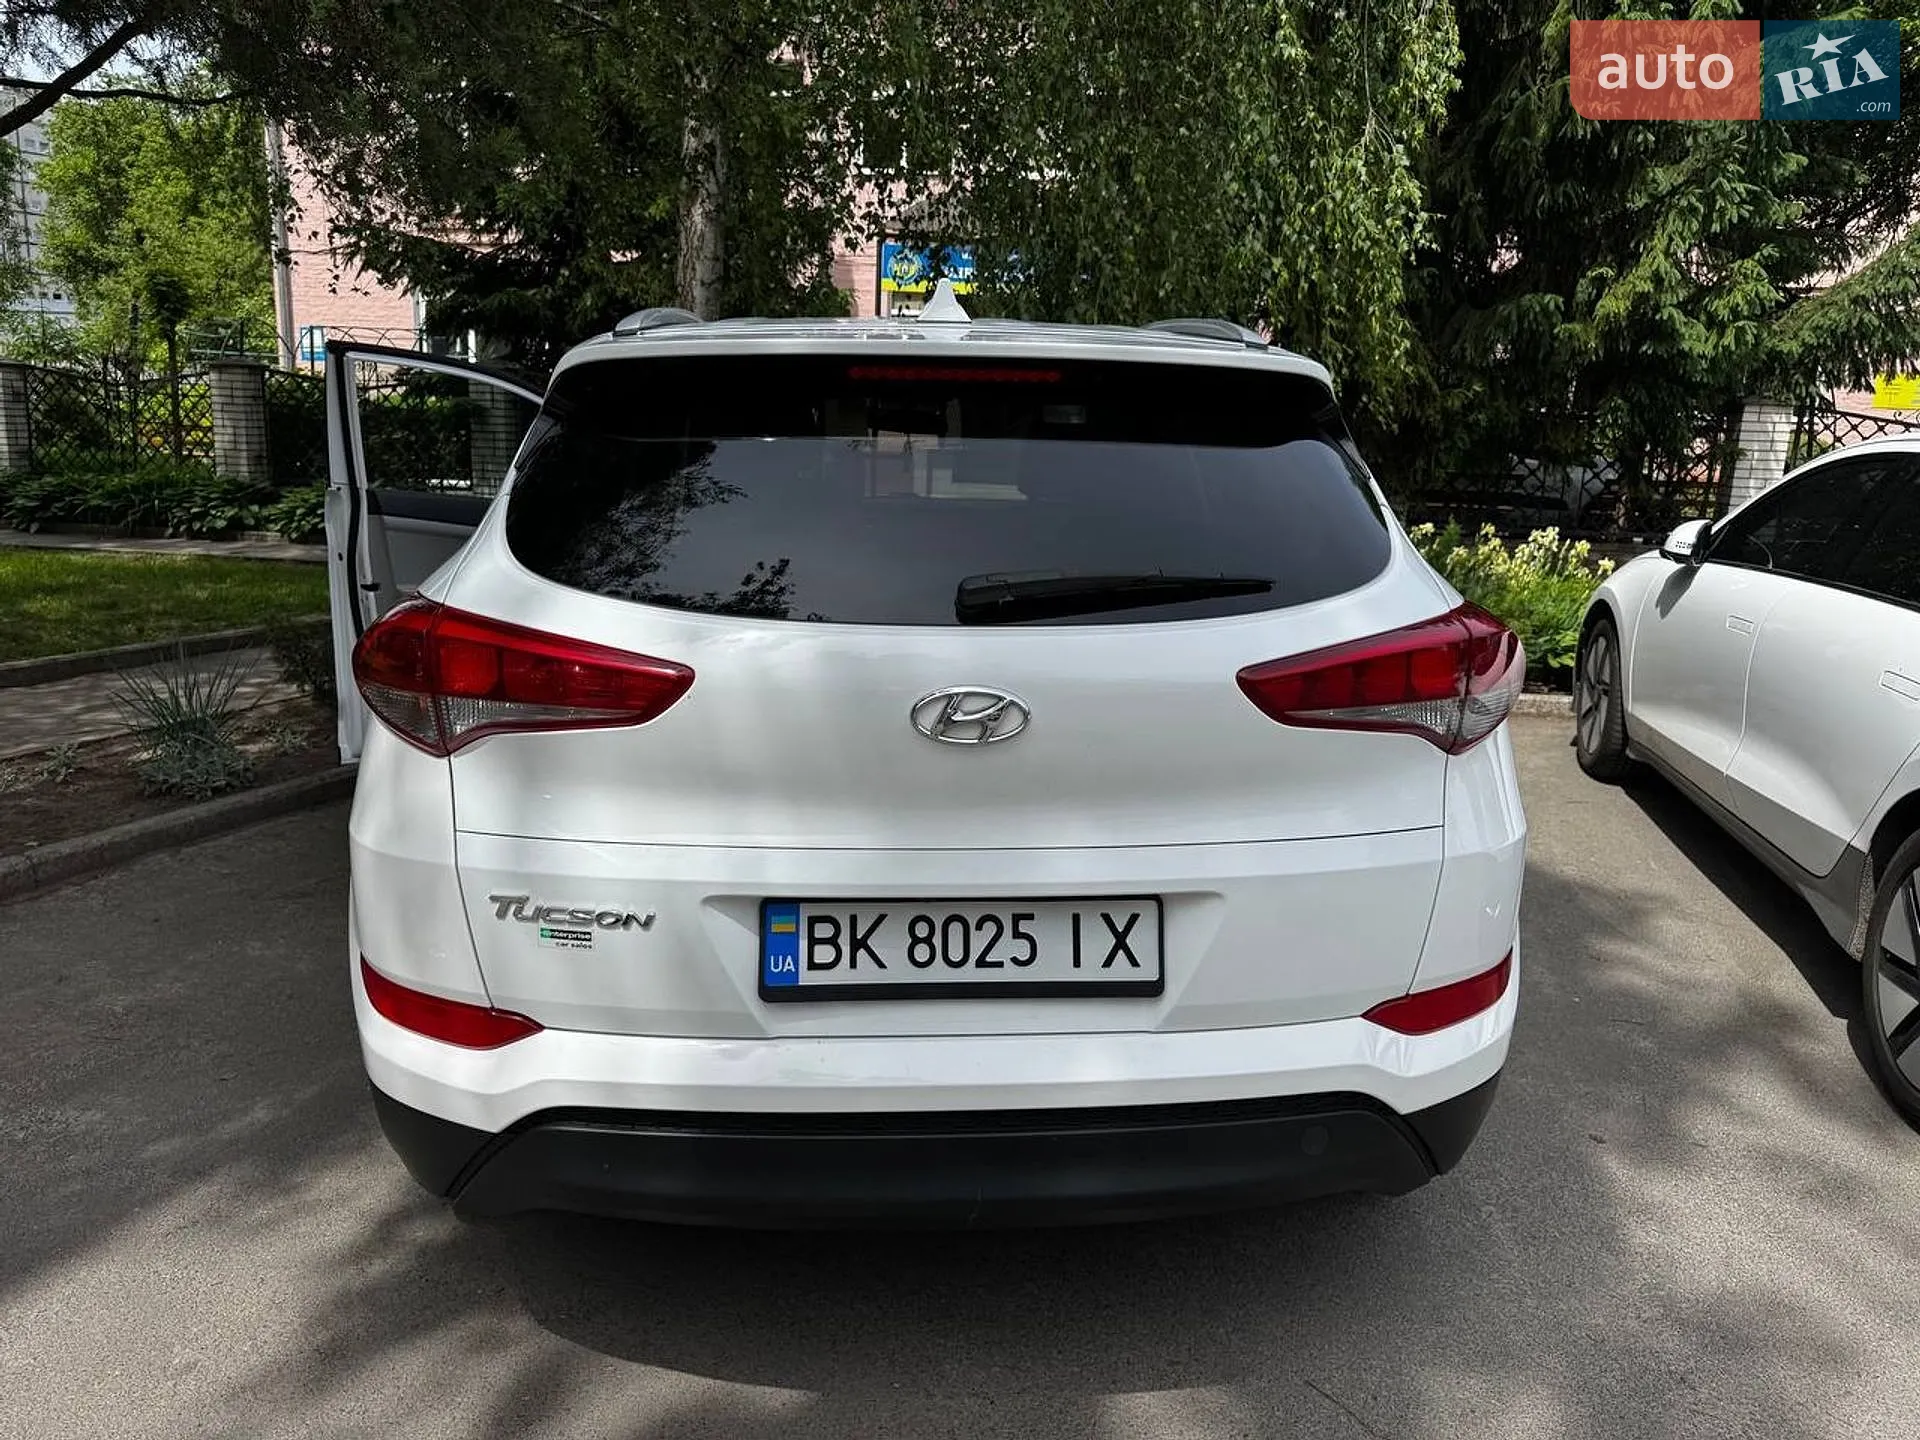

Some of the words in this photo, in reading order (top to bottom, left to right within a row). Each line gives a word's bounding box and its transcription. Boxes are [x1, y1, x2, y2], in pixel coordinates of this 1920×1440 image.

[806, 912, 888, 971] BK
[907, 912, 1038, 969] 8025
[1072, 912, 1142, 969] IX
[769, 955, 796, 974] UA
